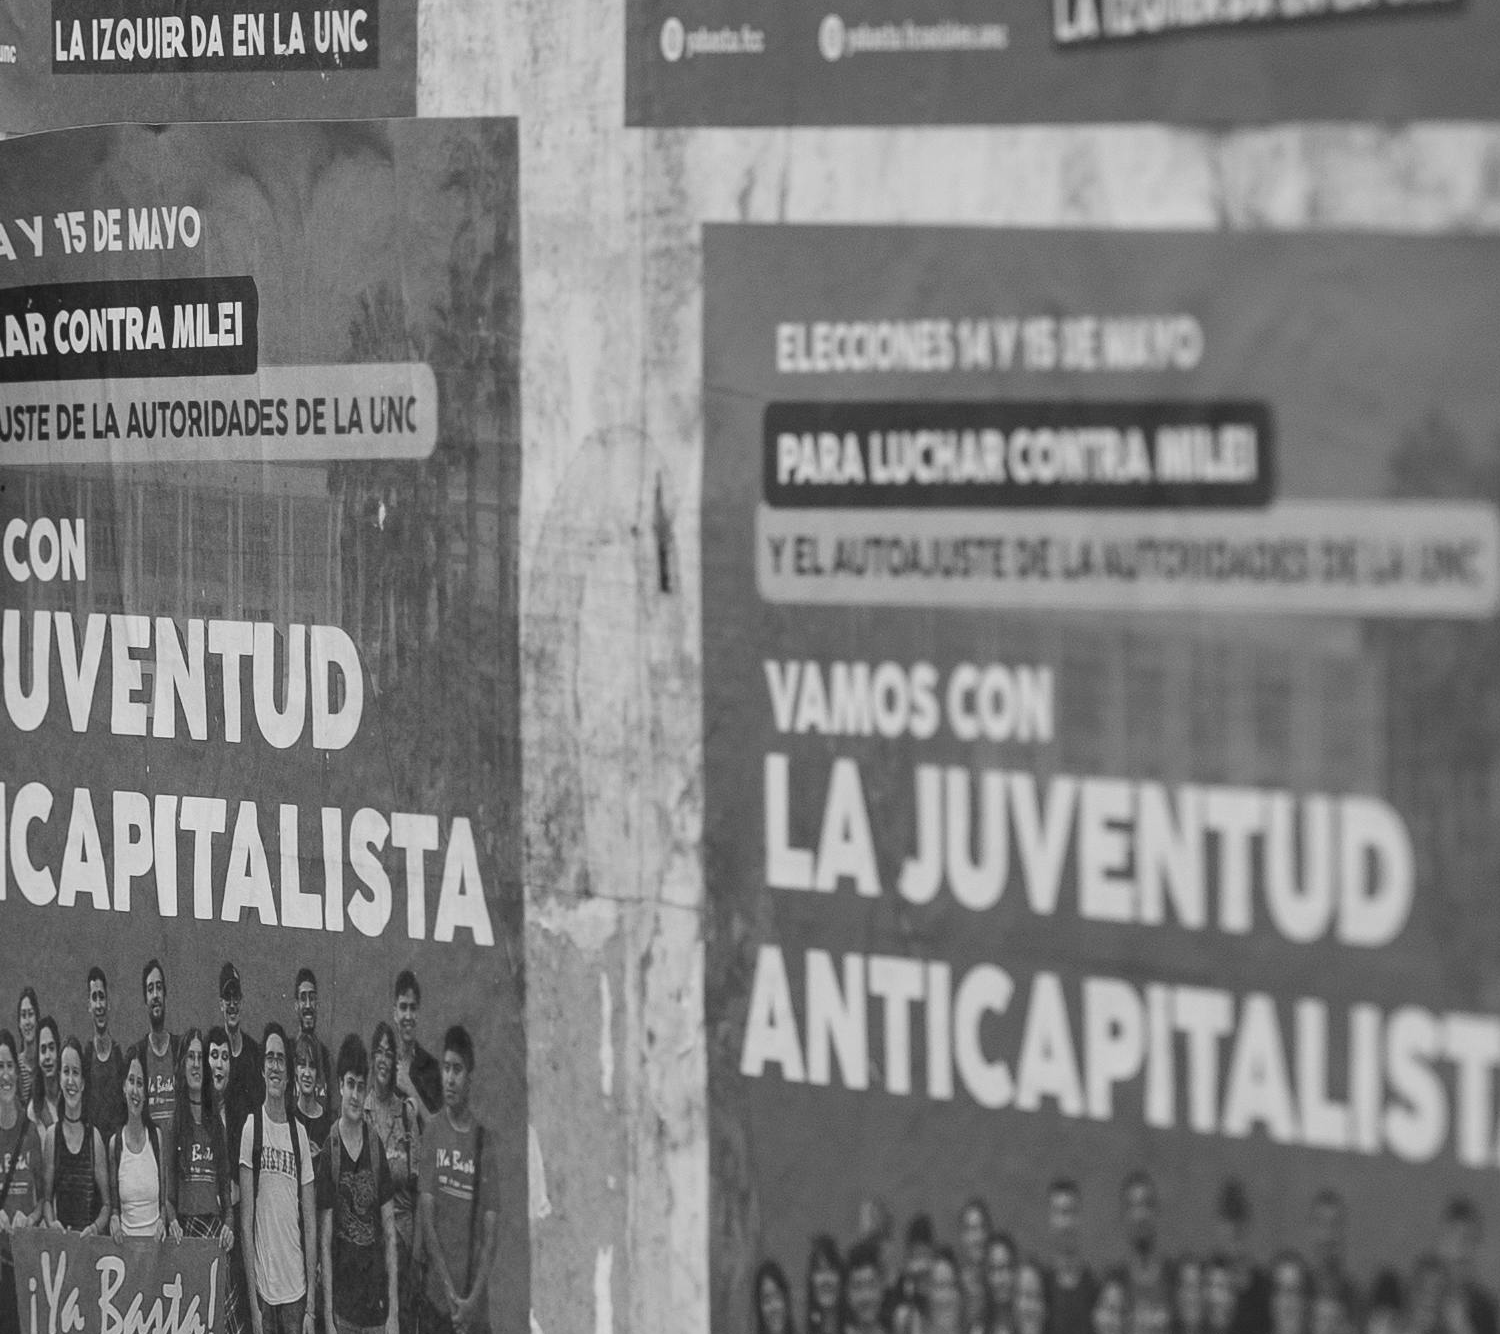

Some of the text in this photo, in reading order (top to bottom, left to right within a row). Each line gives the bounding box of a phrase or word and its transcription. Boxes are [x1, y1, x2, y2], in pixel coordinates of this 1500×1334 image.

[55, 8, 367, 62] LA IZQUIERDA EN LA UNC
[16, 219, 46, 257] Y
[55, 211, 86, 254] 15
[93, 208, 123, 252] DE
[128, 205, 201, 252] MAYO
[54, 307, 165, 354] CONTRA
[171, 302, 243, 349] MILEI
[56, 403, 87, 441] DE
[93, 403, 121, 440] LA
[126, 398, 289, 440] AUTORIDADES
[297, 397, 328, 436] DE
[334, 397, 364, 435] LA
[370, 395, 417, 434] UNC
[776, 432, 864, 485] PARA
[3, 518, 87, 583] CON
[764, 660, 1053, 742] VAMOS CON
[765, 752, 1414, 947] LA JUVENTUD
